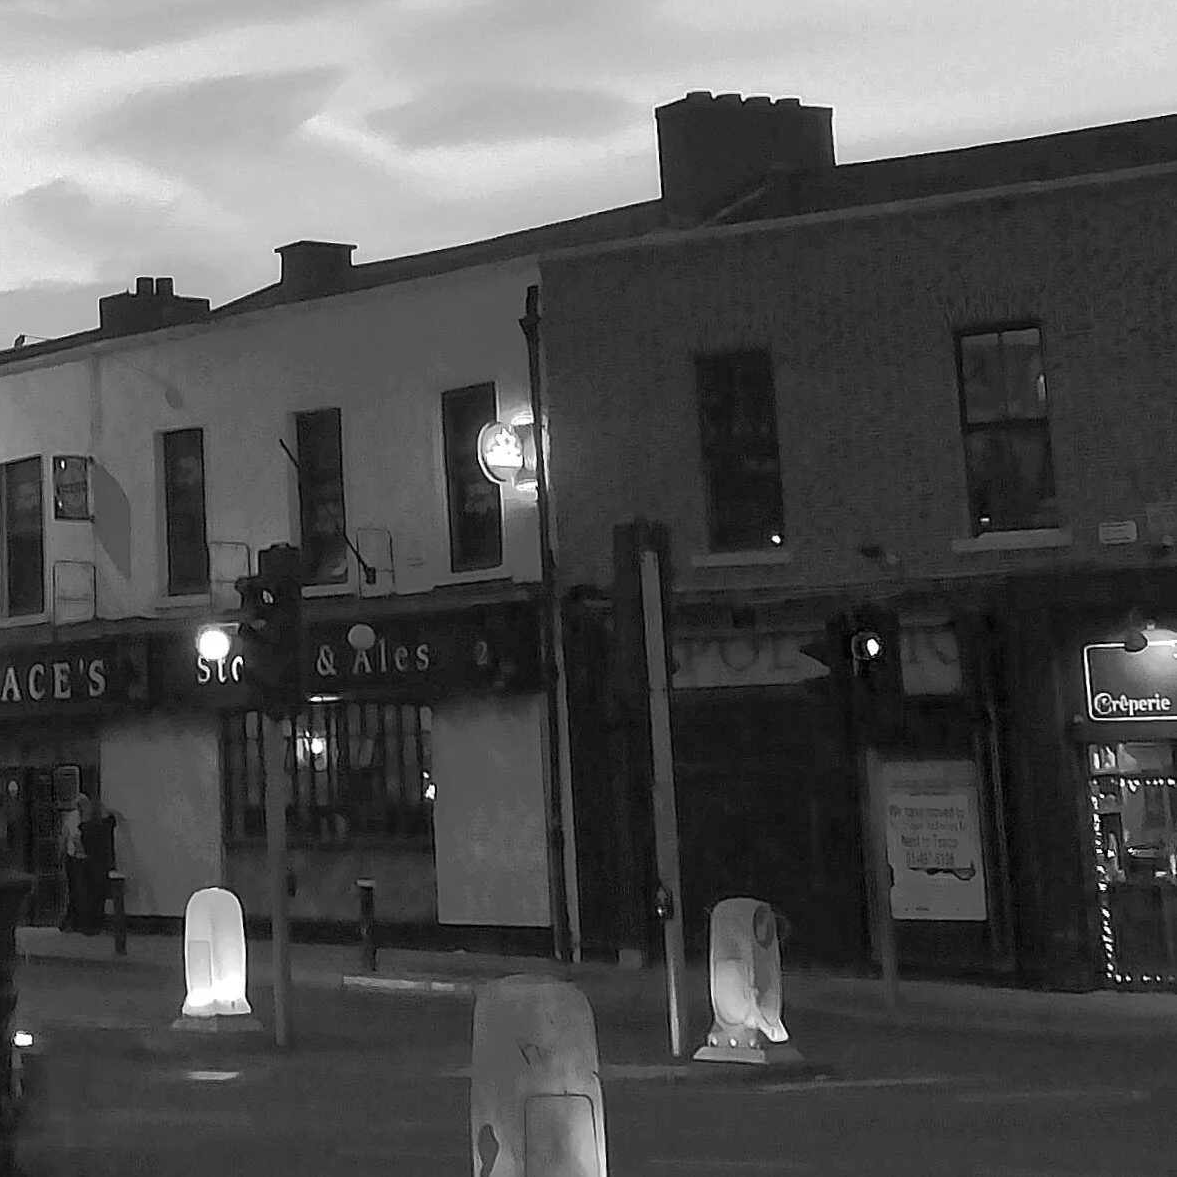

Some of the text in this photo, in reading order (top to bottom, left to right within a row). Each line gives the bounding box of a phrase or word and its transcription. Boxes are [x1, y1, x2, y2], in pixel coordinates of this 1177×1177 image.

[317, 644, 337, 677] &
[352, 637, 430, 675] Ales
[1093, 692, 1172, 717] Crêperie
